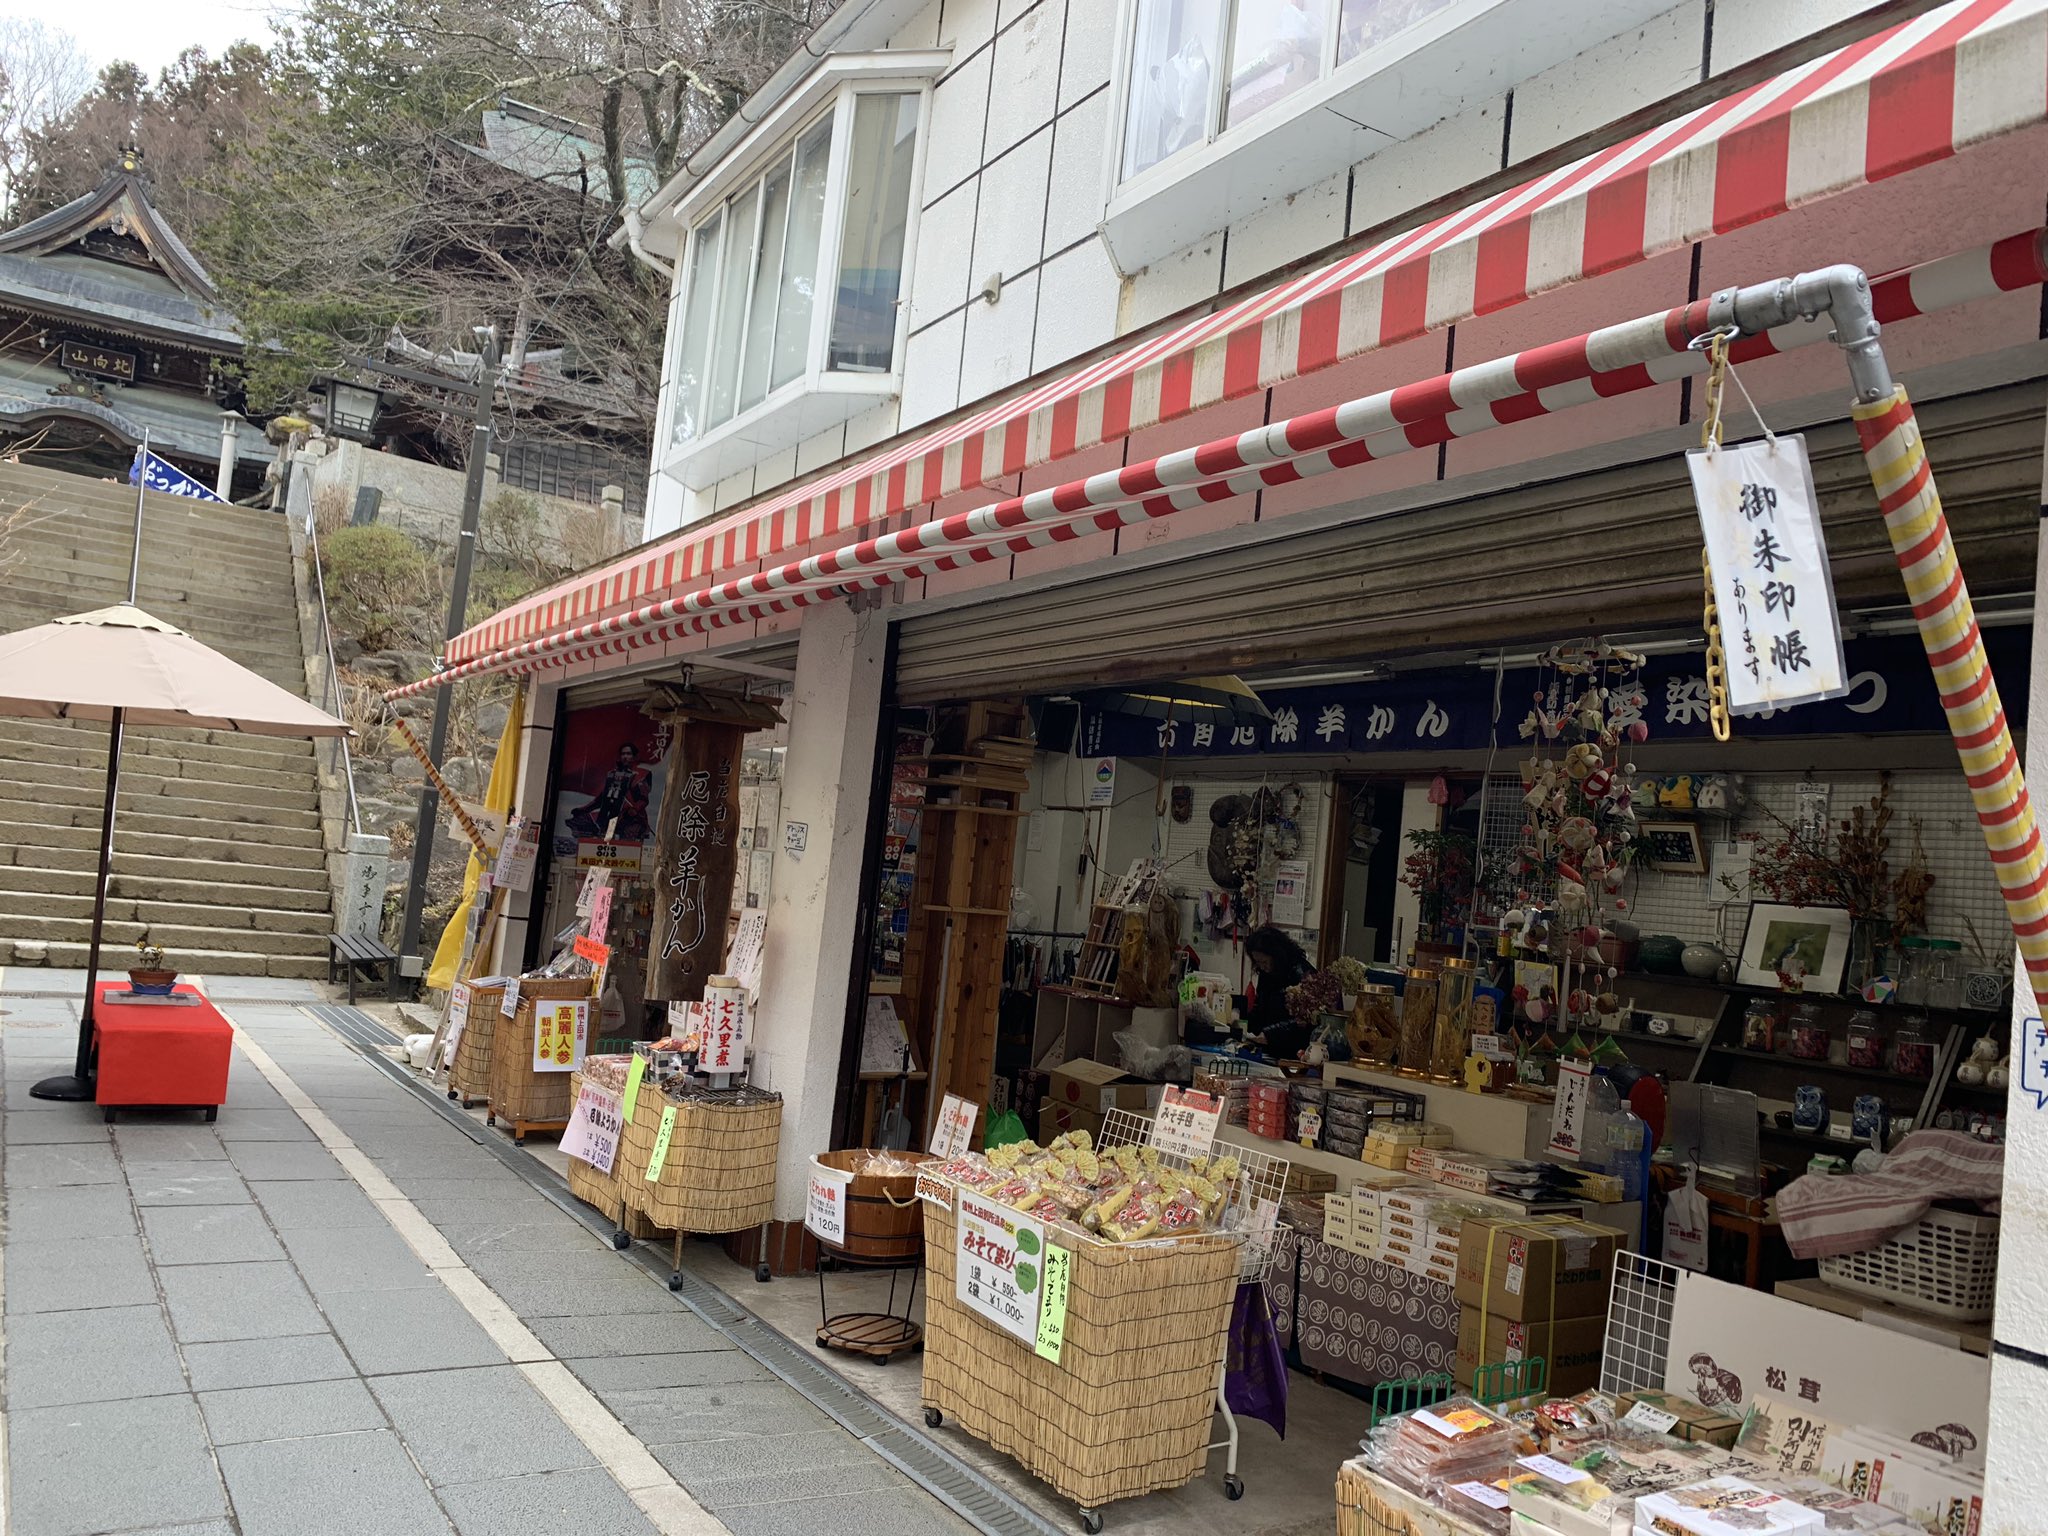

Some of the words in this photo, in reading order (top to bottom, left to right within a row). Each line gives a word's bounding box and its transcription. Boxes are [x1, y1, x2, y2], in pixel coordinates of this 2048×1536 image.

[1739, 483, 1811, 675] 御朱印帳
[662, 770, 711, 960] 厄除羊かん
[540, 1017, 552, 1059] 朝鮮人参
[556, 1006, 572, 1065] 高麗人参
[577, 1006, 585, 1041] 信州上田市
[700, 997, 712, 1065] 七久里煮
[715, 999, 736, 1067] 七久里煮
[818, 1217, 840, 1235] 120円
[963, 1230, 1016, 1270] みそてまり
[1765, 1366, 1822, 1404] 松茸
